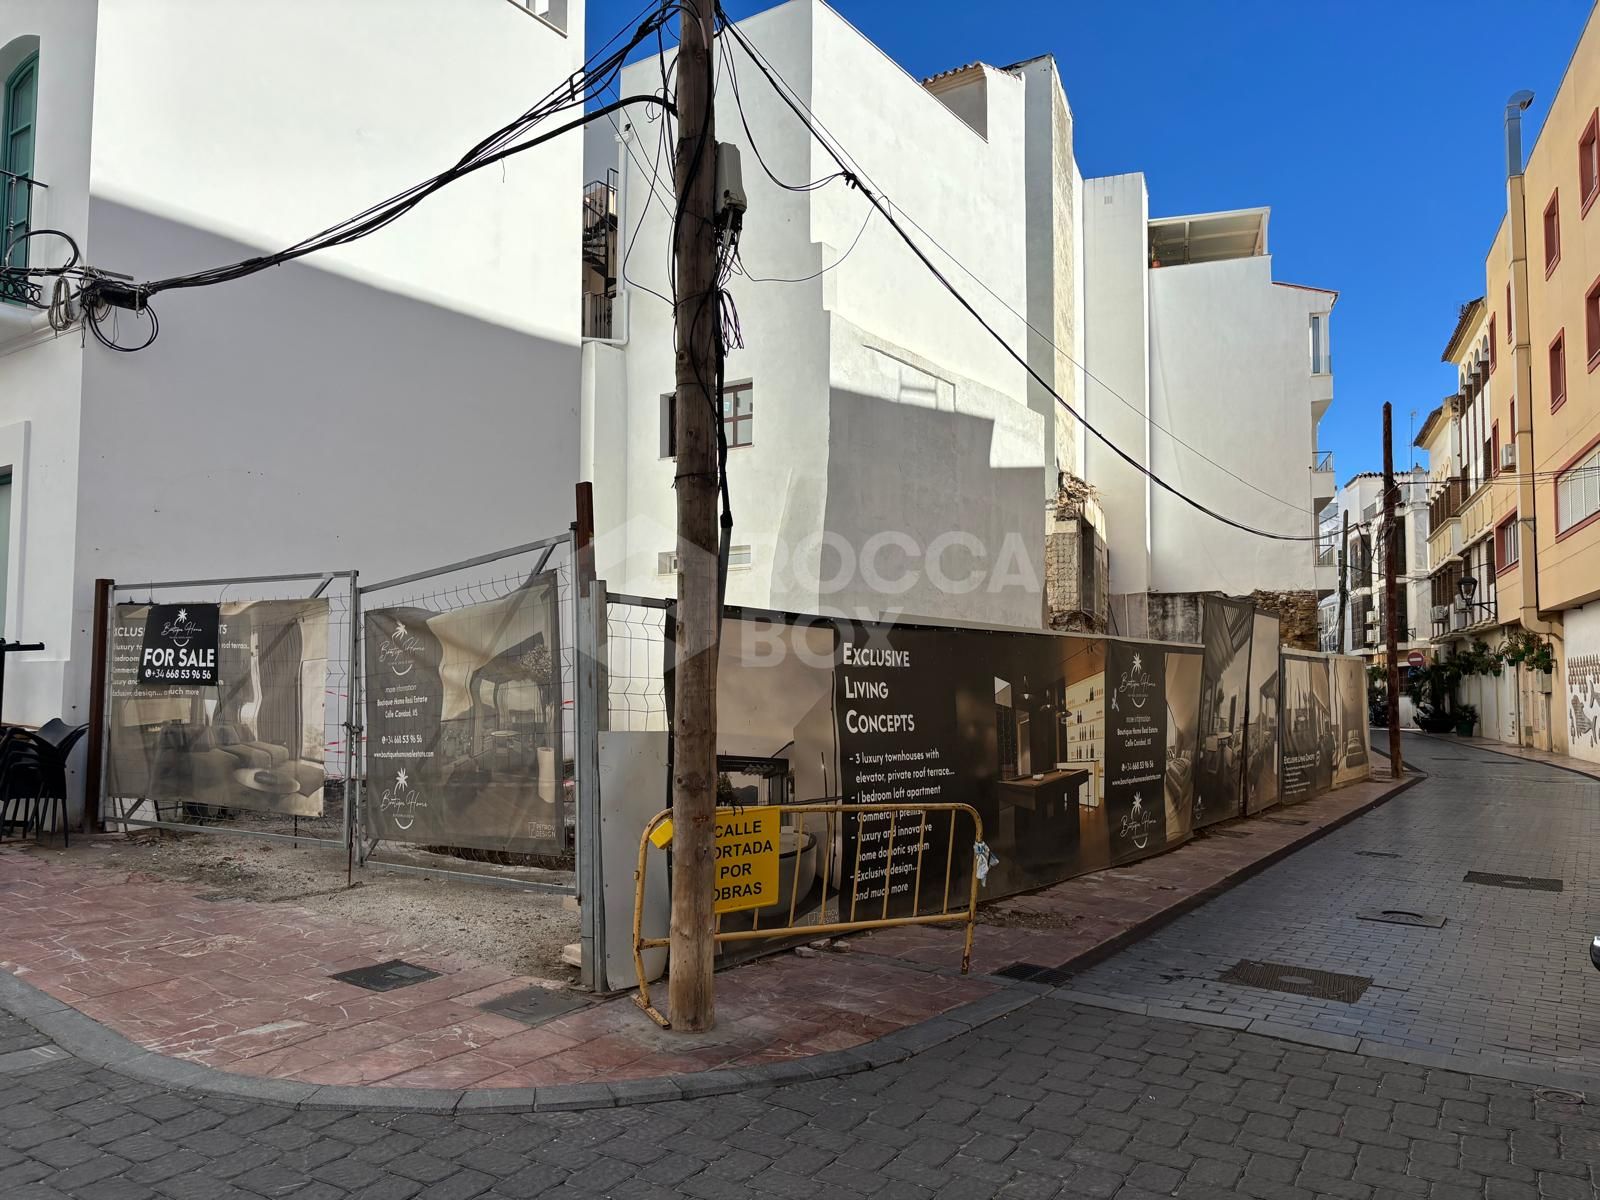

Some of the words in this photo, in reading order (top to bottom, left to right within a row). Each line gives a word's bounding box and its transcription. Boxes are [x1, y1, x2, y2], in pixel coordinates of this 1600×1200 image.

[143, 648, 175, 667] FOR
[178, 648, 215, 667] SALE
[843, 642, 910, 667] EXCLUSIVE
[165, 669, 180, 679] 668
[180, 669, 190, 679] 53
[191, 669, 201, 679] 96
[202, 669, 212, 680] 56
[844, 675, 889, 699] LIVING
[846, 709, 915, 733] CONCEPTS
[402, 734, 409, 744] 53
[855, 752, 861, 764] 3
[861, 751, 884, 766] luxury
[884, 750, 924, 762] townhouses
[925, 747, 940, 760] with
[855, 771, 887, 784] elevator,
[887, 769, 912, 784] private
[912, 766, 926, 779] roof
[927, 767, 955, 778] terrace...
[861, 789, 892, 803] bedroom
[893, 786, 905, 799] loft
[906, 784, 941, 800] apartment
[857, 810, 898, 823] Commercil
[715, 820, 762, 838] CALLE
[858, 831, 881, 844] uxury
[897, 823, 932, 836] innovave
[715, 840, 773, 860] ORTADA
[878, 844, 905, 858] dootic
[907, 842, 930, 855] systm
[720, 863, 752, 880] POR
[890, 862, 917, 876] design..
[714, 882, 762, 901] OBRAS
[891, 883, 909, 894] more
